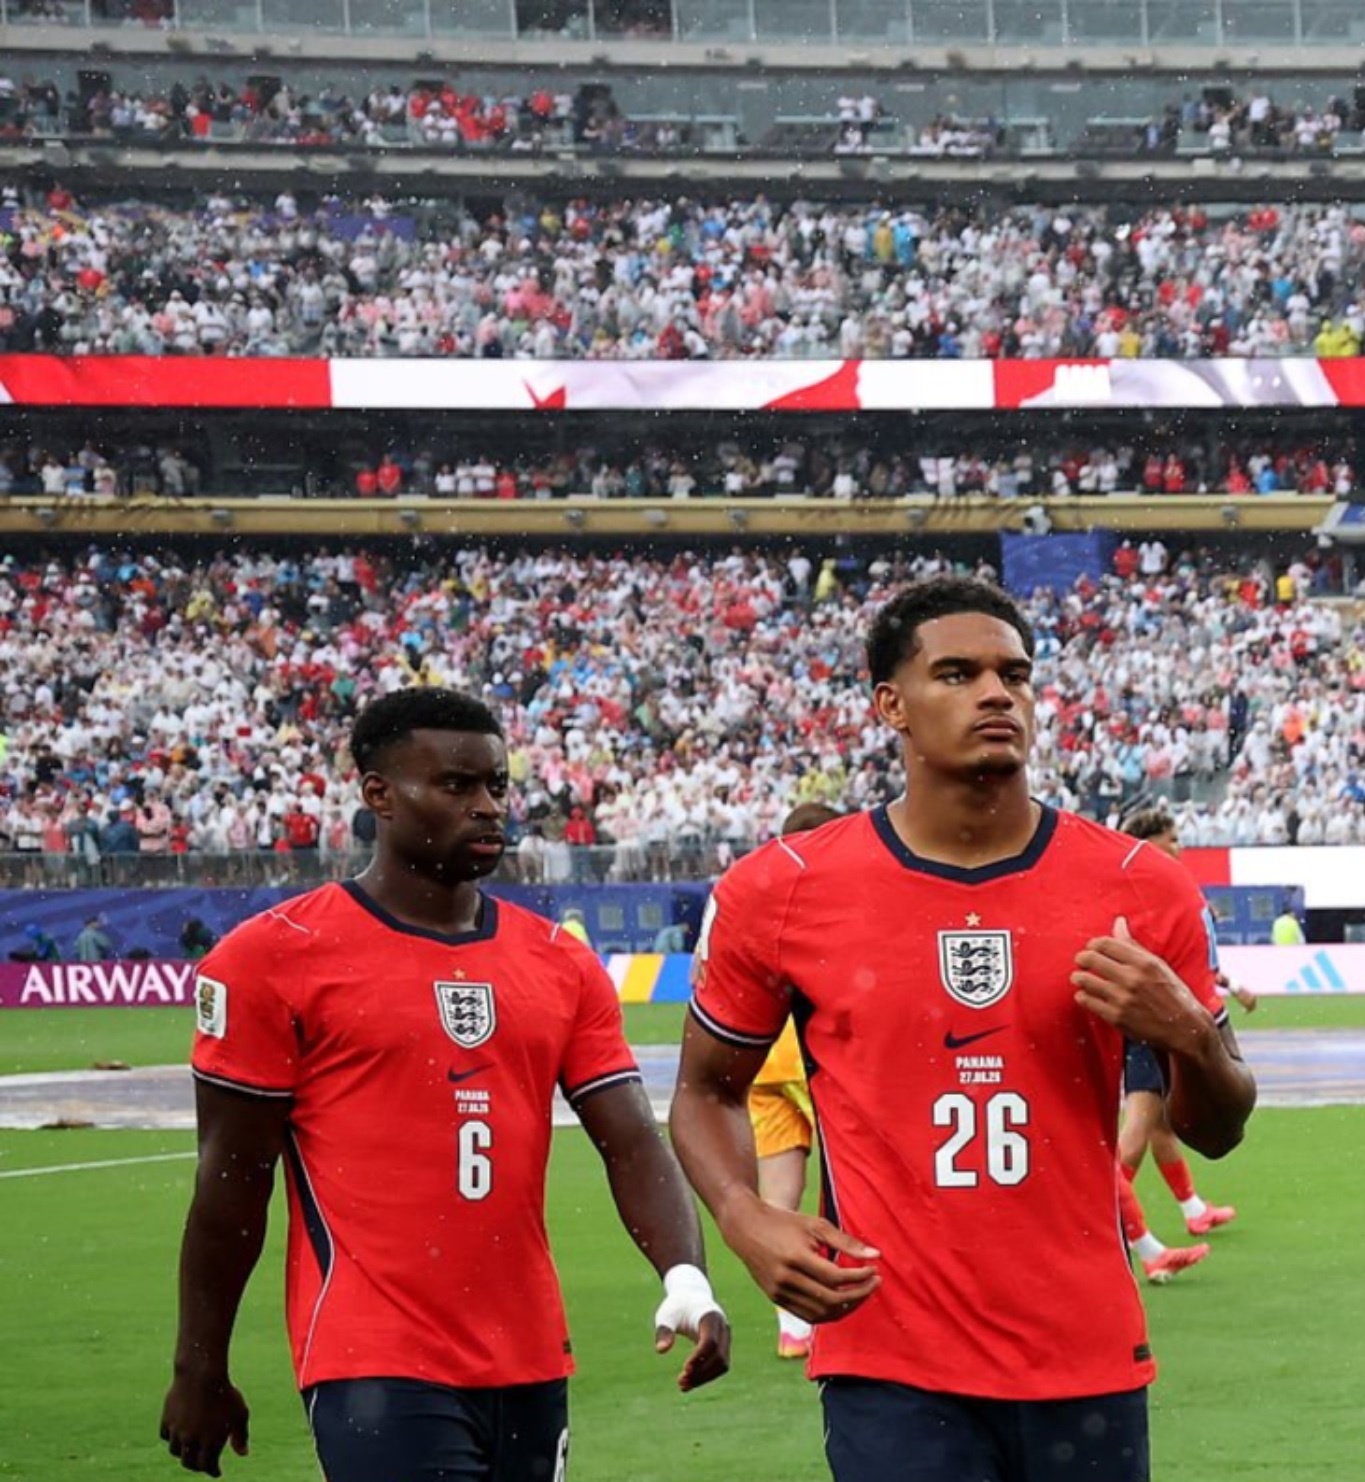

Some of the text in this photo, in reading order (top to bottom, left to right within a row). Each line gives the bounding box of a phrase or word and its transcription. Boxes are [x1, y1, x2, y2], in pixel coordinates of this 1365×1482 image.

[20, 963, 198, 1003] AIRWAY
[459, 1120, 491, 1200] 6
[932, 1091, 1029, 1187] 26
